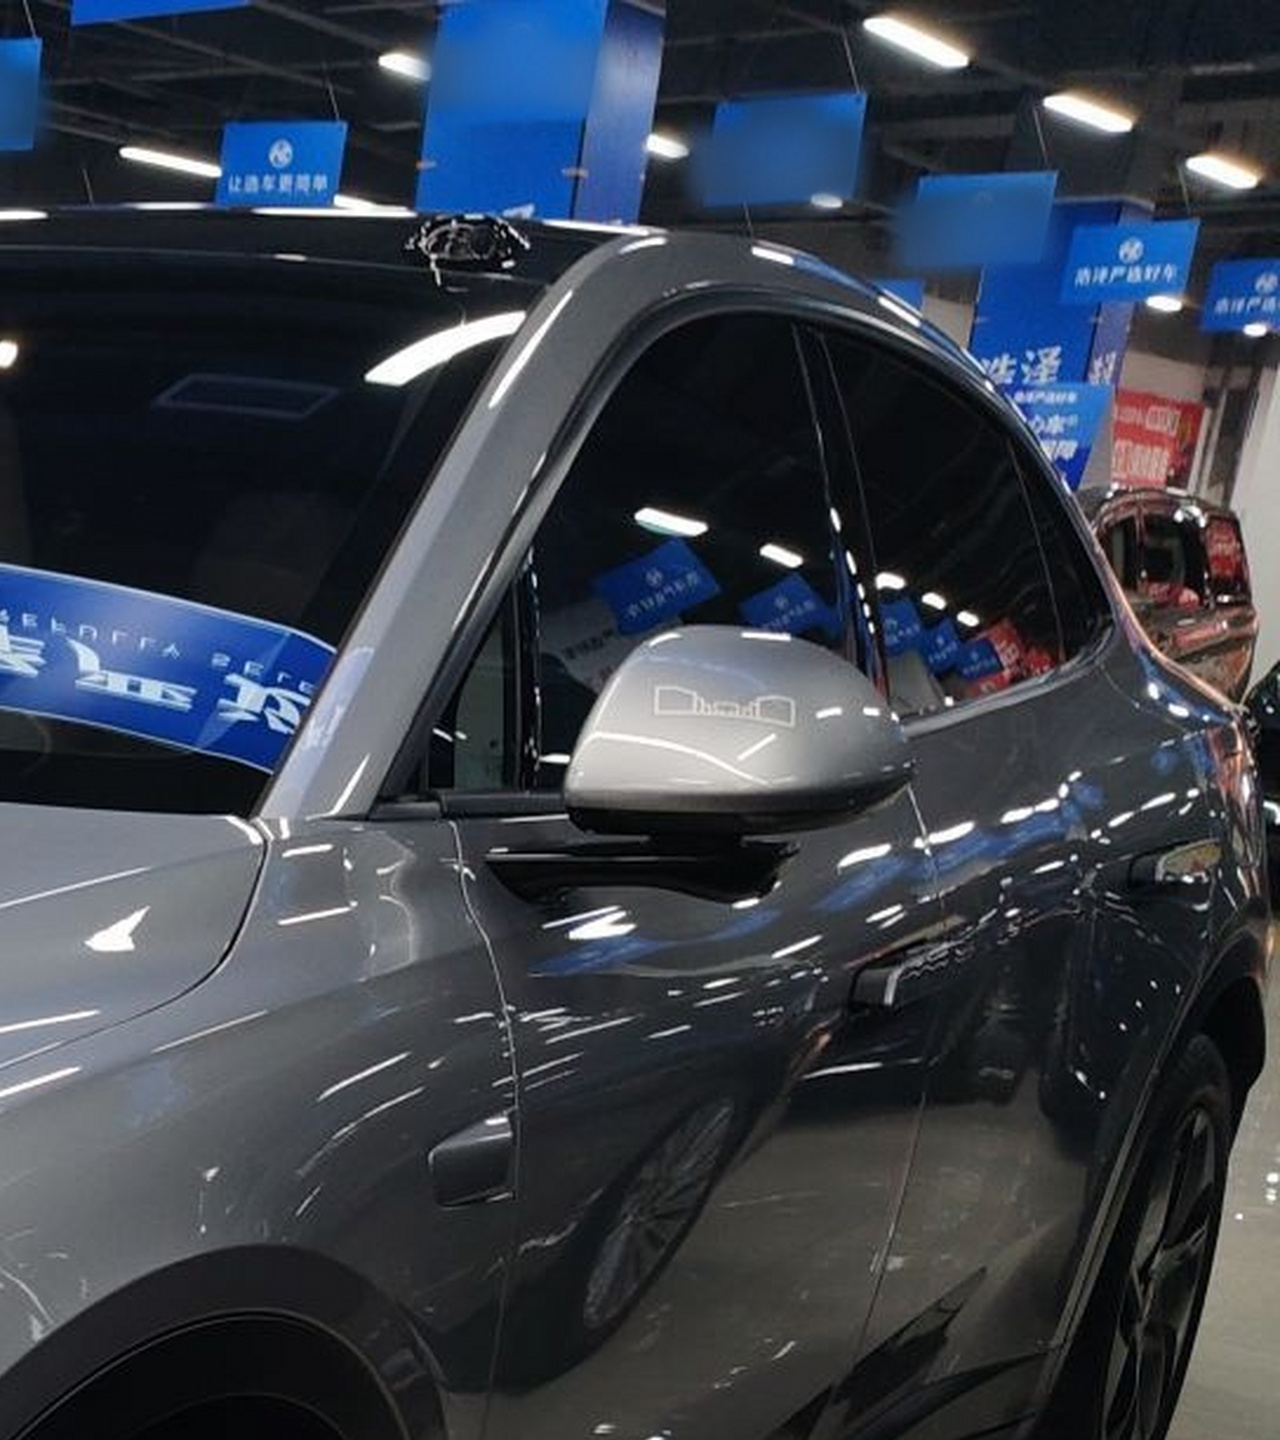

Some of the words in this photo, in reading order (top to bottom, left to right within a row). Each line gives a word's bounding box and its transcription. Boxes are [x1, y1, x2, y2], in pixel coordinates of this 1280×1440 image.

[227, 172, 329, 195] 让选车更简单
[1074, 262, 1178, 286] 浩泽严选好车
